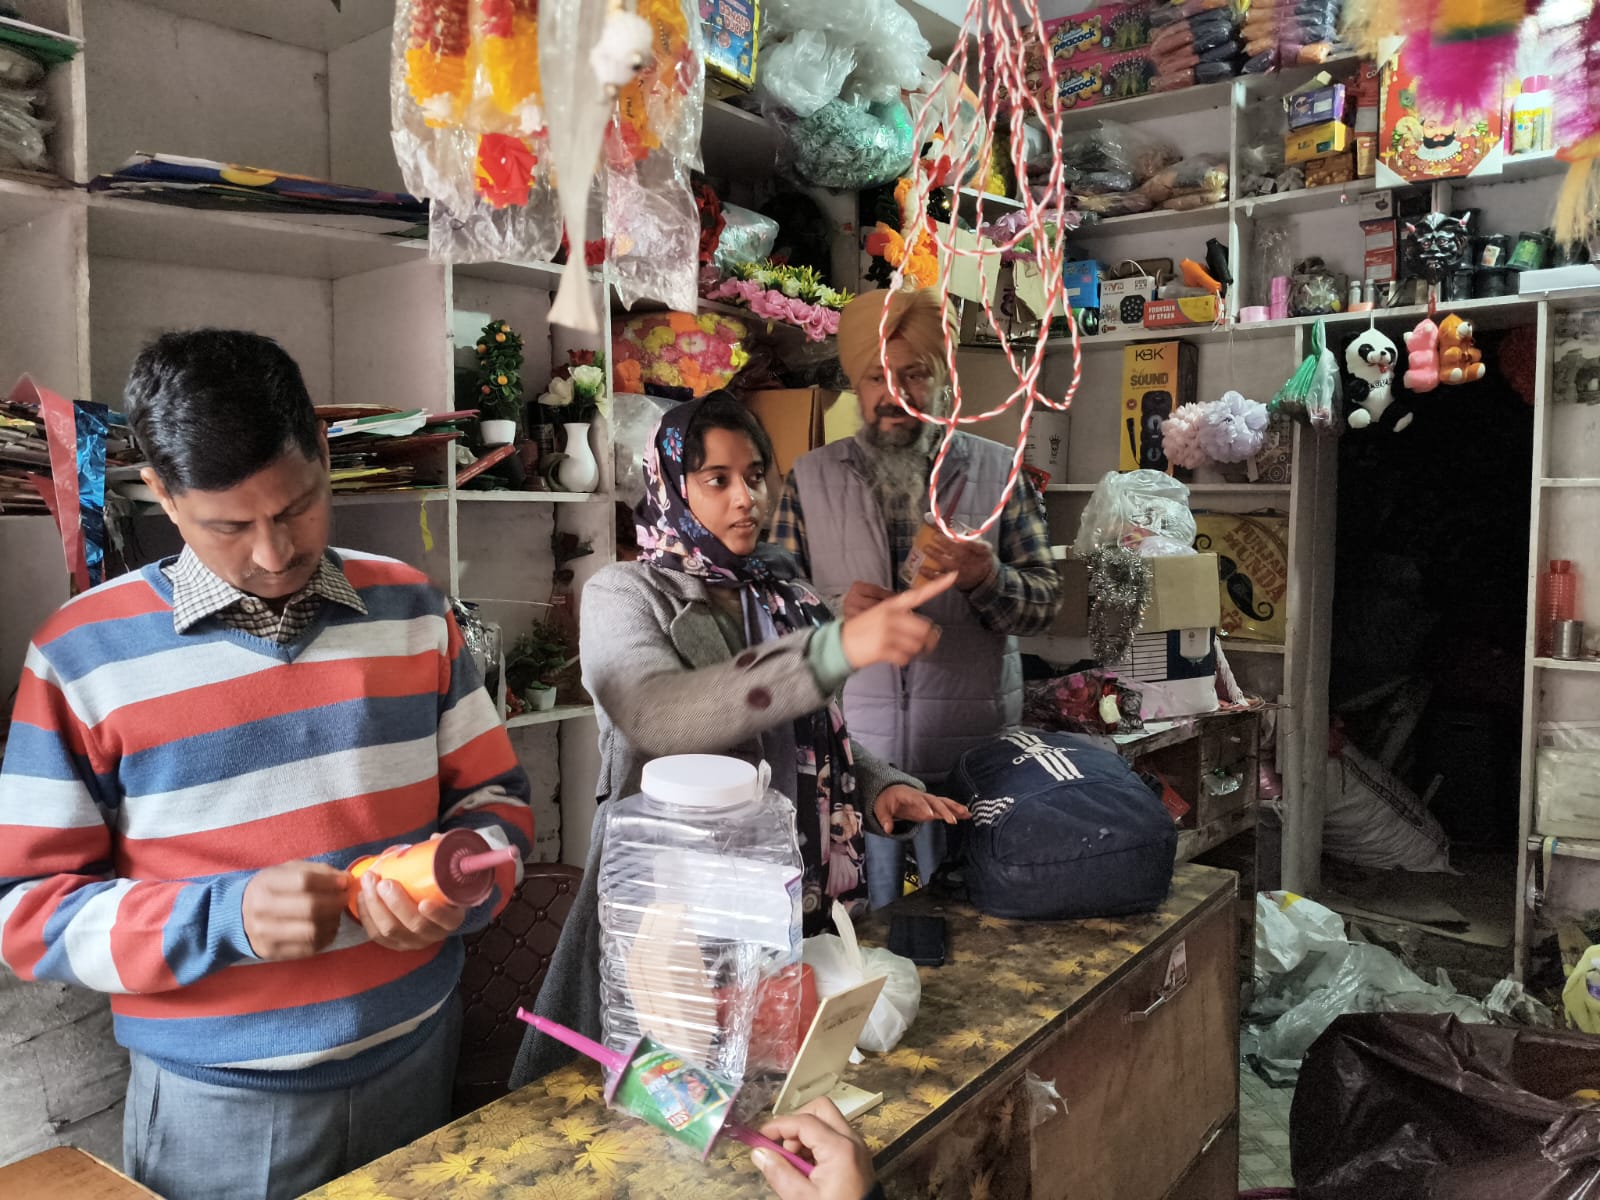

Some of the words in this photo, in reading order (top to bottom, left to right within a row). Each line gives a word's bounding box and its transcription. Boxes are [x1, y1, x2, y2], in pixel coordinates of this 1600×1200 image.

[719, 1, 751, 31] DONALD
[724, 15, 746, 38] DUCK
[1053, 28, 1096, 56] peacock
[1058, 74, 1097, 98] eacock
[1148, 304, 1176, 313] FOUNTAIN
[1130, 373, 1168, 387] SOUND
[1223, 531, 1286, 603] MUNDA
